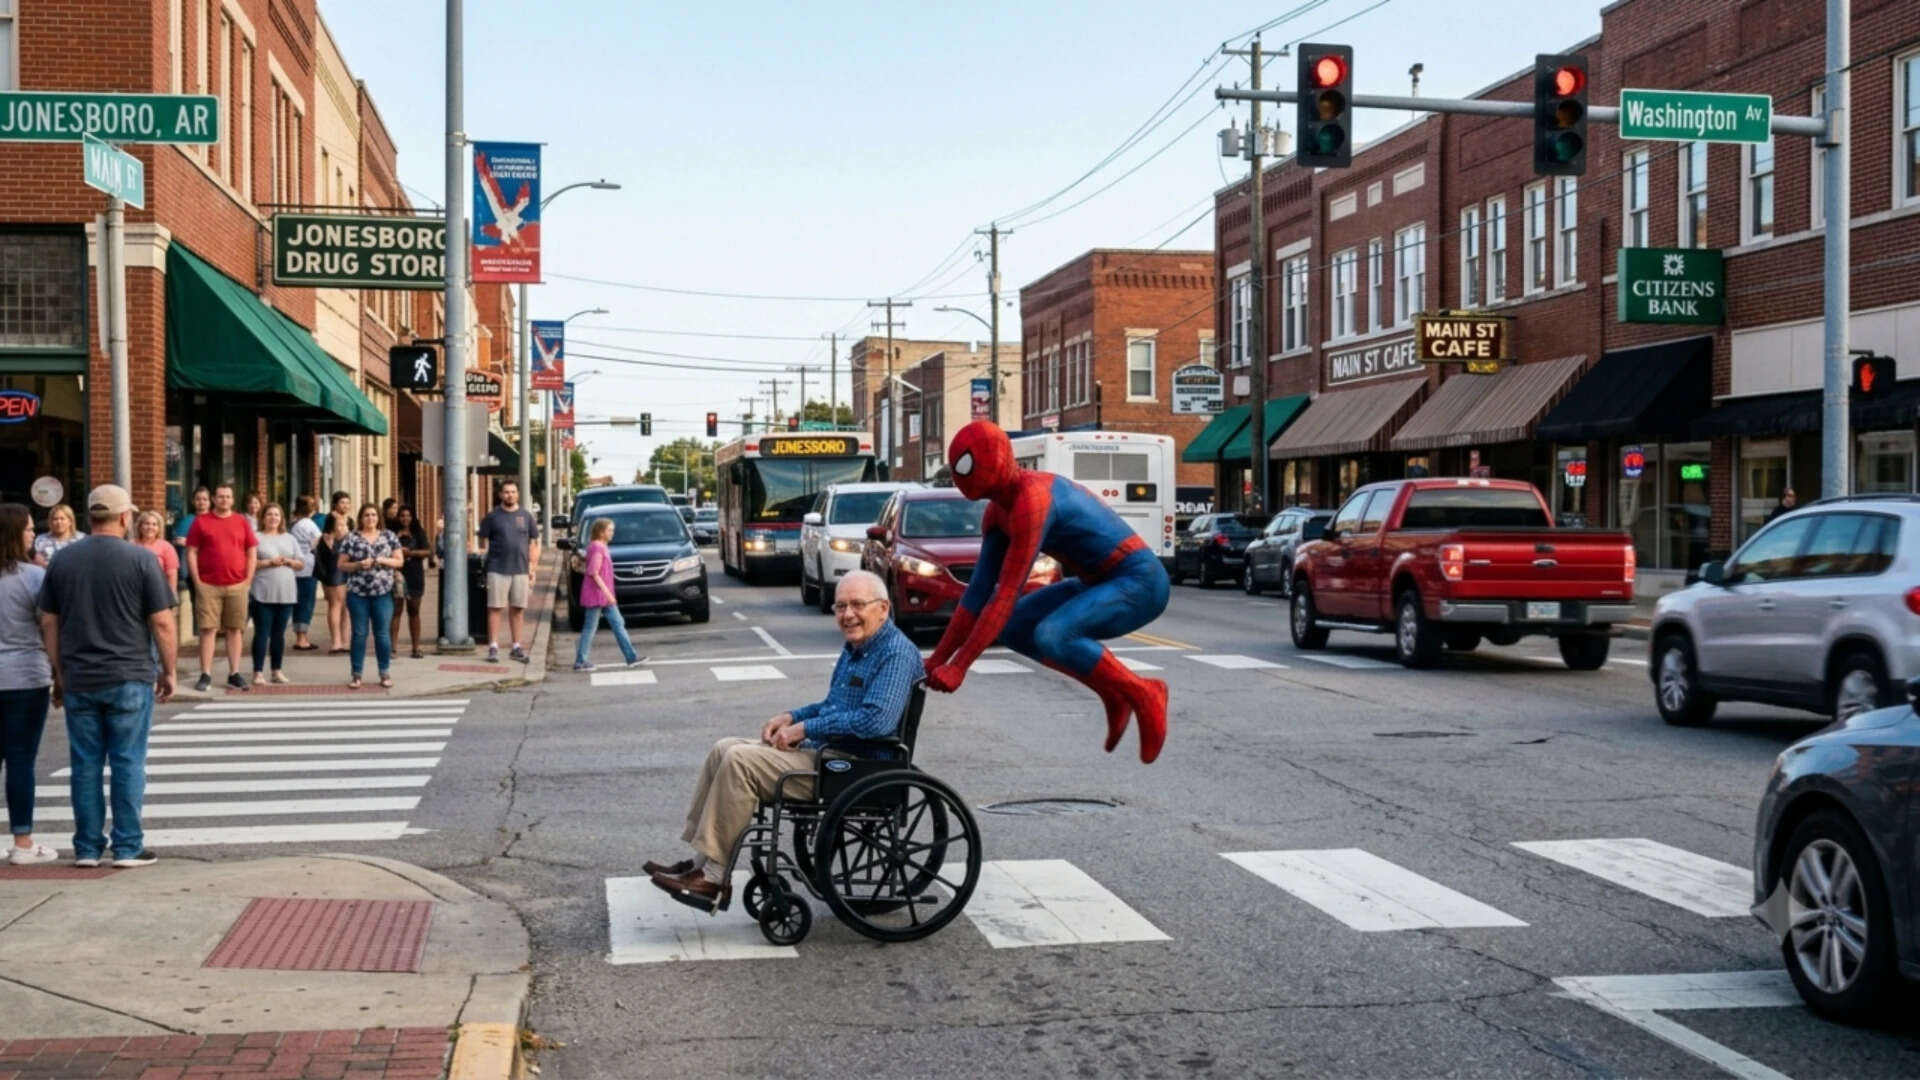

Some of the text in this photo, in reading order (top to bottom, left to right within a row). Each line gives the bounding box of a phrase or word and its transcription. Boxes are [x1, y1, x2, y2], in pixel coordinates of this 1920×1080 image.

[1, 101, 209, 138] JONESBORO, AR
[1627, 100, 1737, 136] Washington
[286, 251, 360, 275] DRUG
[1632, 280, 1715, 298] CITIZENS
[1648, 299, 1699, 316] BANK
[1425, 322, 1498, 338] MAIN ST
[1431, 340, 1491, 357] CAFE
[1332, 341, 1416, 379] MAIN ST CAFE
